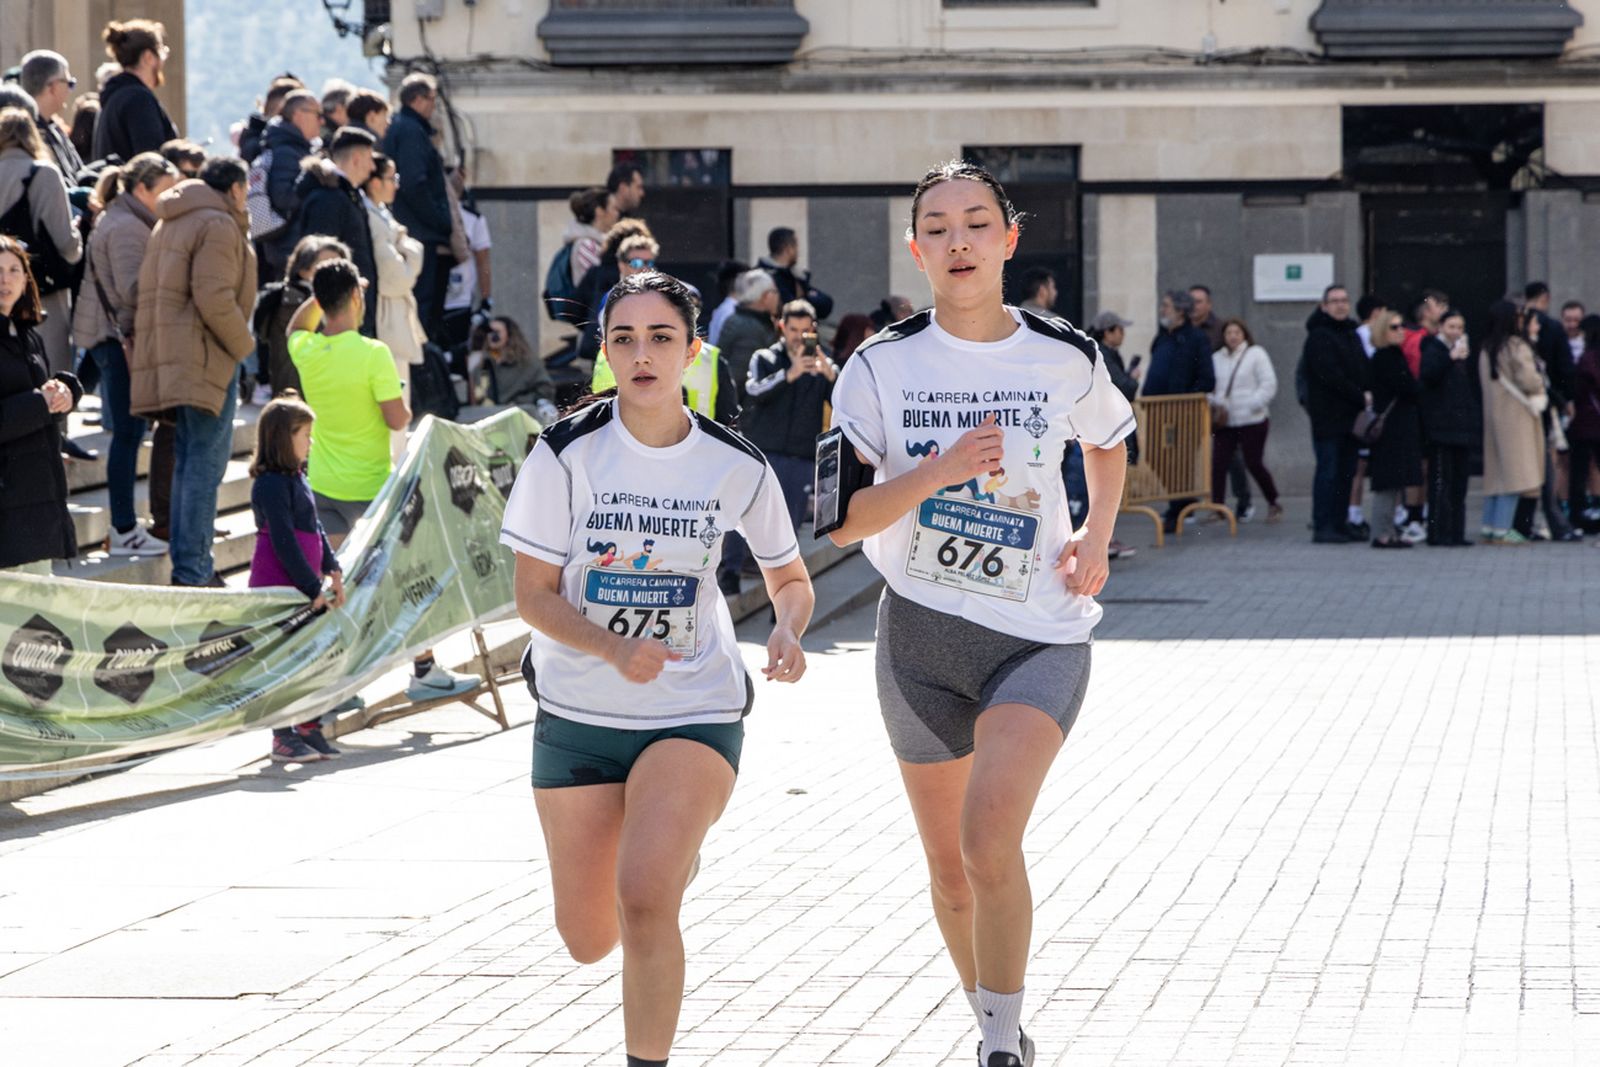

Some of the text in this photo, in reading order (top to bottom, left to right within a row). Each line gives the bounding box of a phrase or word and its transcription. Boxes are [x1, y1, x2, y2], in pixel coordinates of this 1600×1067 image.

[902, 389, 1048, 404] VI CARRERA CAMINATA
[903, 409, 952, 428] BUENA
[601, 492, 658, 509] CARRERA
[586, 510, 698, 538] BUENA MUERTE
[934, 502, 1025, 527] VI CARRERA CAMINATA
[931, 512, 1005, 541] BUENA MUERTE
[937, 535, 1004, 578] 676
[600, 575, 687, 587] VI CARRERA CAMINATA
[597, 587, 669, 604] BUENA MUERTE
[608, 608, 670, 639] 675
